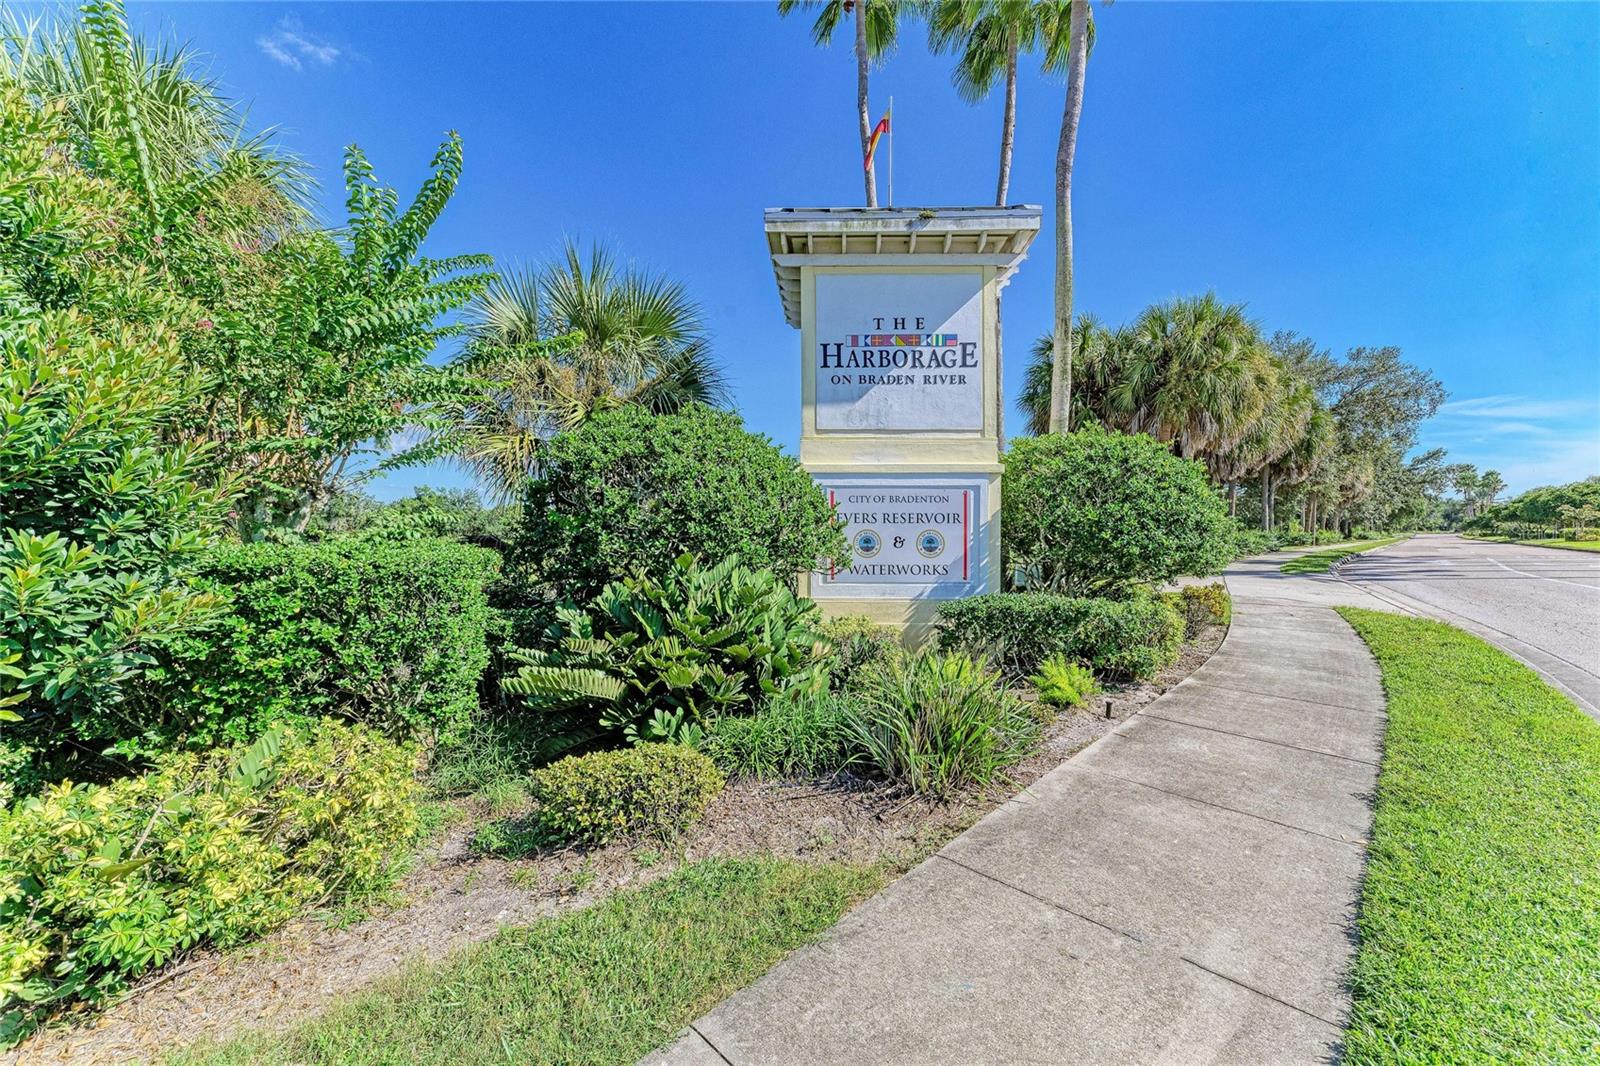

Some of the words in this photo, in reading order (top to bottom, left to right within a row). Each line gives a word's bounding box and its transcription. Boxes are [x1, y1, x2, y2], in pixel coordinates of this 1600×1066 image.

[873, 317, 926, 330] THE
[820, 342, 978, 369] HARBORAGE
[831, 374, 852, 385] ON
[858, 374, 915, 385] BRADEN
[923, 374, 967, 385] RIVER
[848, 495, 871, 504] CITY
[873, 495, 887, 504] OF
[889, 495, 950, 504] BRADENTON
[836, 512, 878, 524] EVERS
[882, 512, 962, 525] RESERVOIR
[893, 536, 906, 549] &
[849, 564, 949, 576] WATERWORKS
